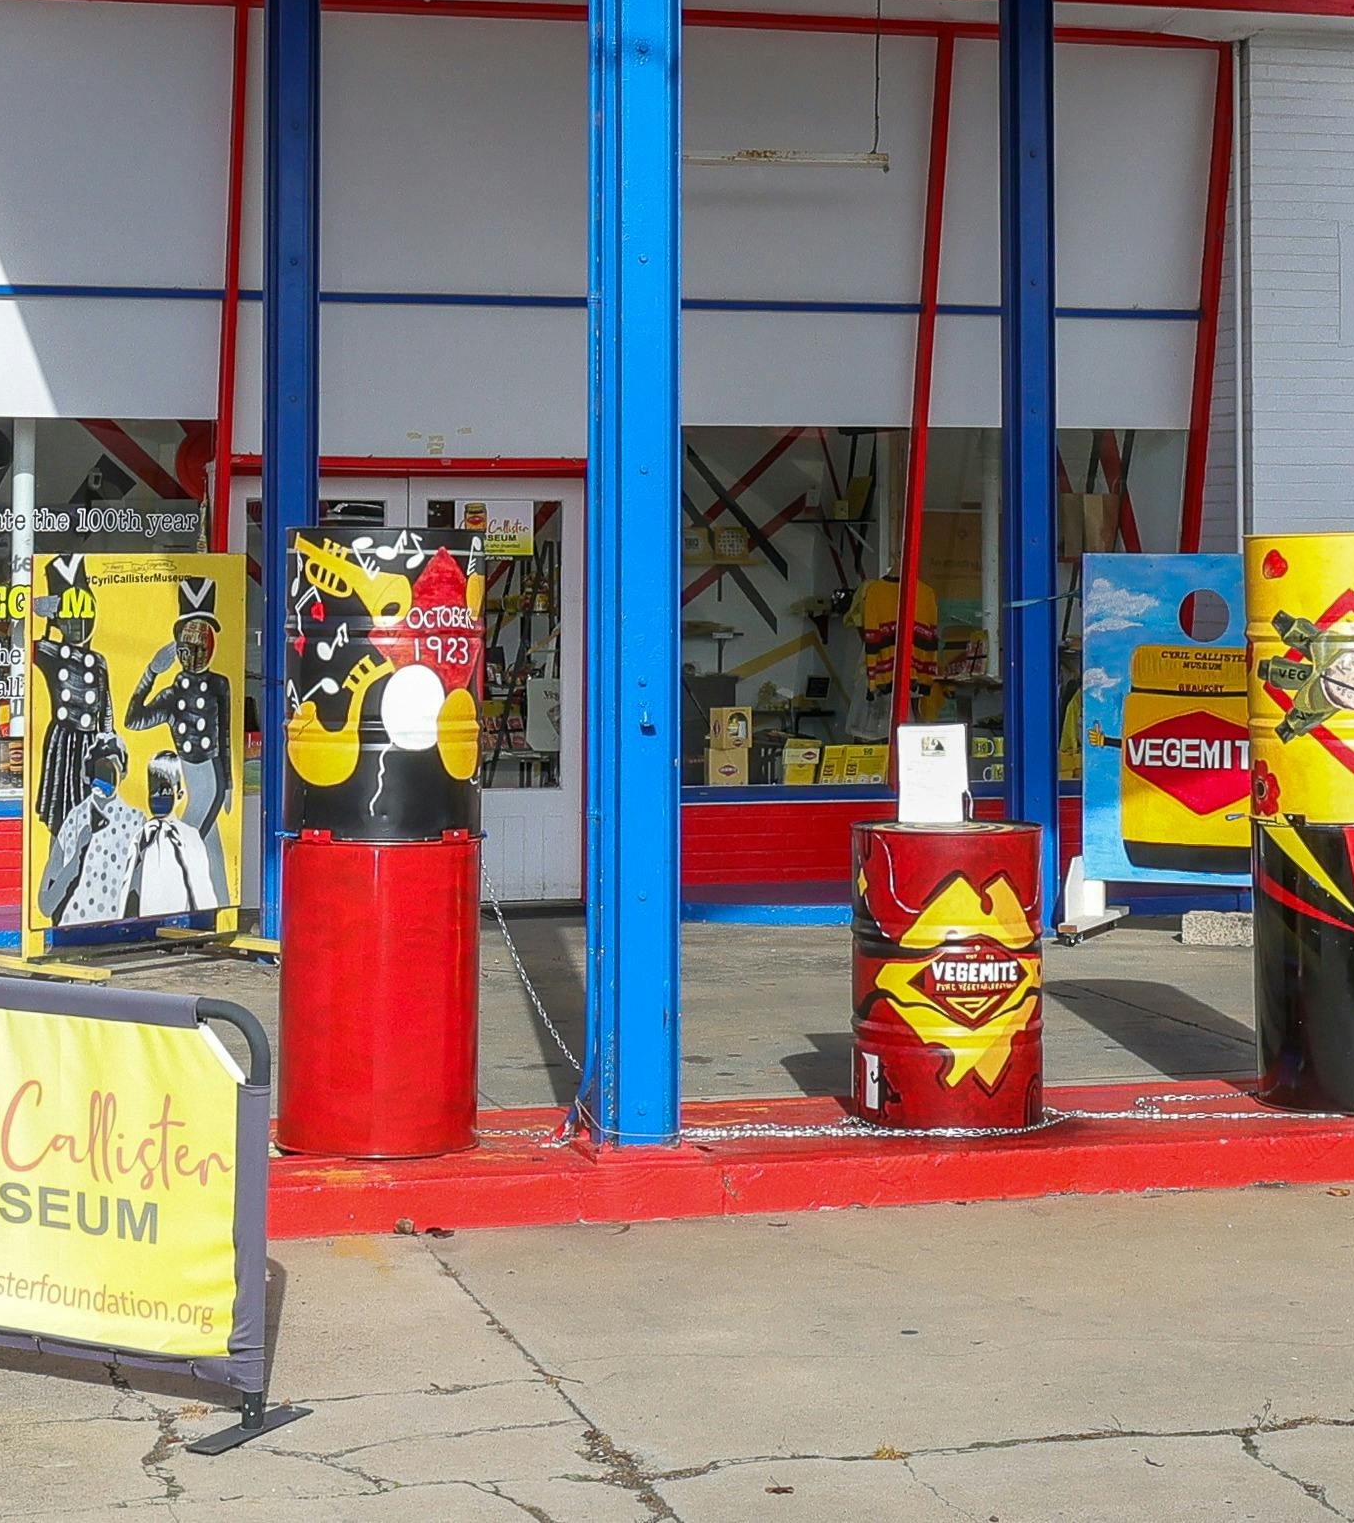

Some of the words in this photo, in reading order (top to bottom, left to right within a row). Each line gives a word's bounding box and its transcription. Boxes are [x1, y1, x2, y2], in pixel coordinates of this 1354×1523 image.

[32, 507, 70, 532] the
[76, 507, 143, 532] 100th
[146, 512, 199, 537] year
[406, 605, 474, 629] OCTOBER
[414, 636, 469, 664] 1923
[1194, 652, 1247, 663] CALLISTE
[1182, 661, 1222, 671] MUSEUM
[1127, 738, 1250, 770] VEGEMIT
[0, 1079, 234, 1192] Callister
